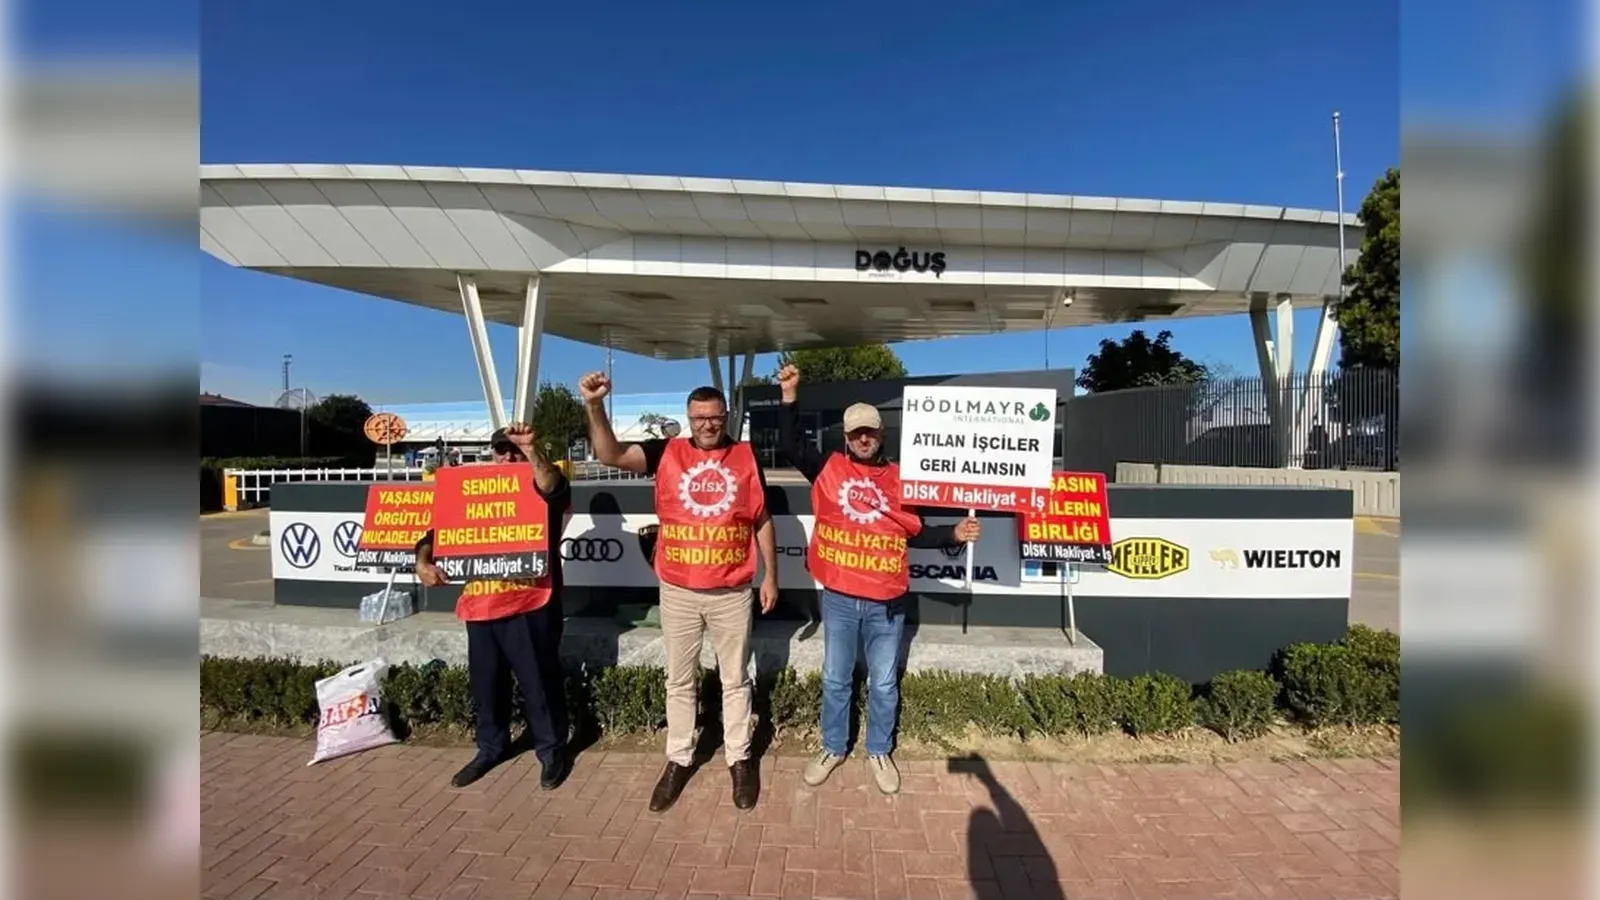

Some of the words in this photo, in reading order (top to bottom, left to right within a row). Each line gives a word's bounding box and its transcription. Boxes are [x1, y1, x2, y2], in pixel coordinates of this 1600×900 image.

[855, 246, 946, 279] DOĞUŞ
[906, 396, 1026, 416] HÖDLMAYR
[953, 414, 1025, 425] INTERNATIONAL
[912, 433, 966, 448] ATILAN
[972, 433, 1040, 453] İŞCİLER
[919, 457, 957, 473] GERİ
[960, 460, 1026, 477] ALINSIN
[462, 474, 520, 496] SENDİKA
[690, 478, 725, 493] DİSK
[379, 490, 435, 508] YAŞASIN
[902, 481, 940, 501] DİSK
[952, 486, 1017, 509] Nakliyat
[1030, 487, 1046, 512] İş
[373, 508, 432, 526] ÖRGÜTLÜ
[465, 501, 517, 520] HAKTIR
[437, 523, 545, 547] ENGELLENEMEZ
[1028, 520, 1100, 542] BİRLİĞİ
[1022, 541, 1048, 558] DİSK
[1054, 545, 1095, 562] Nakliyat
[1243, 549, 1341, 568] WIELTON
[473, 557, 522, 578] Nakliyat
[532, 552, 544, 576] İş
[909, 564, 999, 581] SCANIA
